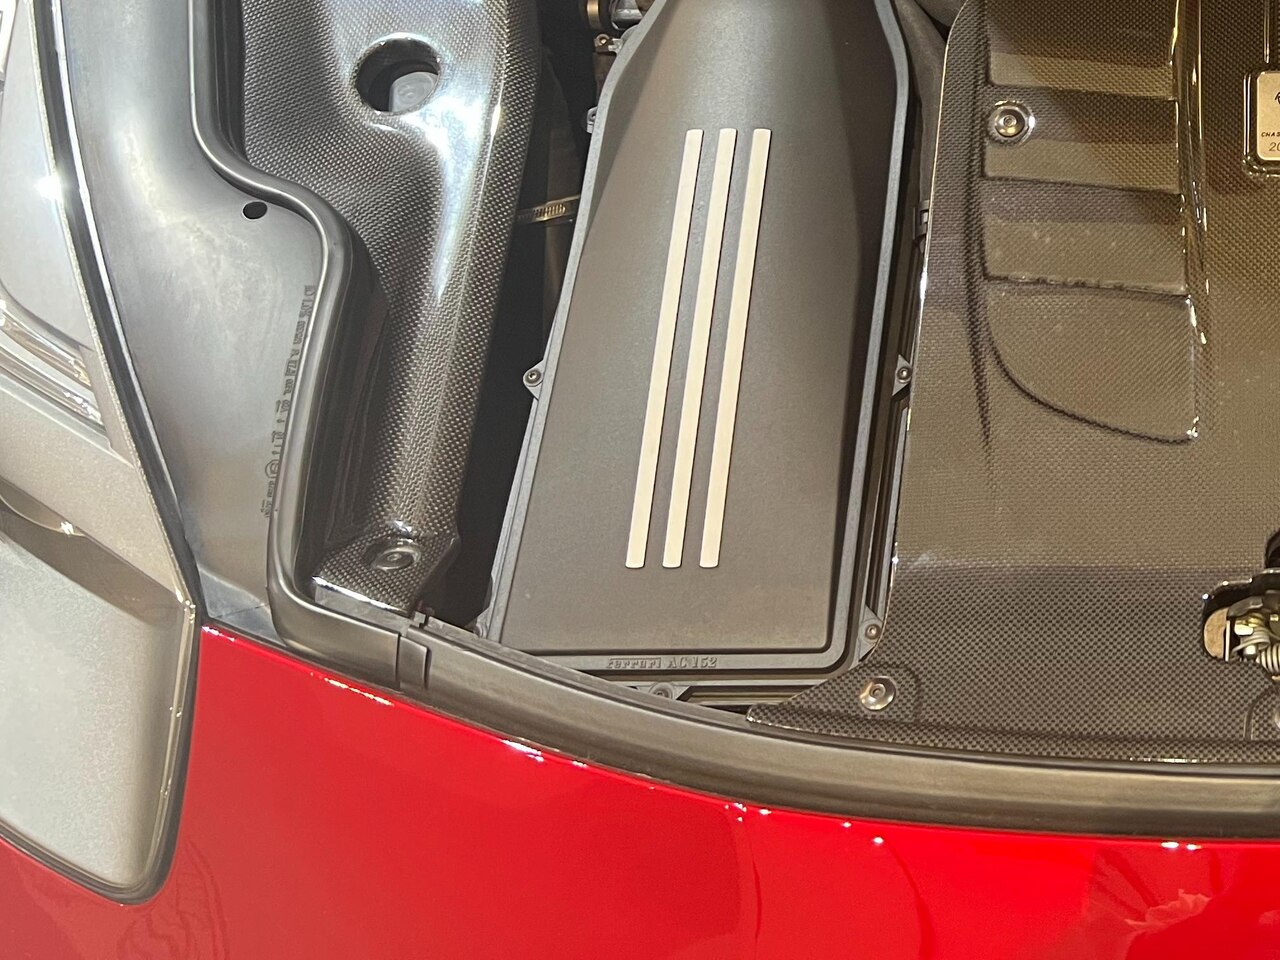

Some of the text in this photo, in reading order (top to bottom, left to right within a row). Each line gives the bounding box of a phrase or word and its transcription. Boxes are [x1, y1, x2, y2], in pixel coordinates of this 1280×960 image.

[607, 657, 718, 668] Ferrari AC 152
